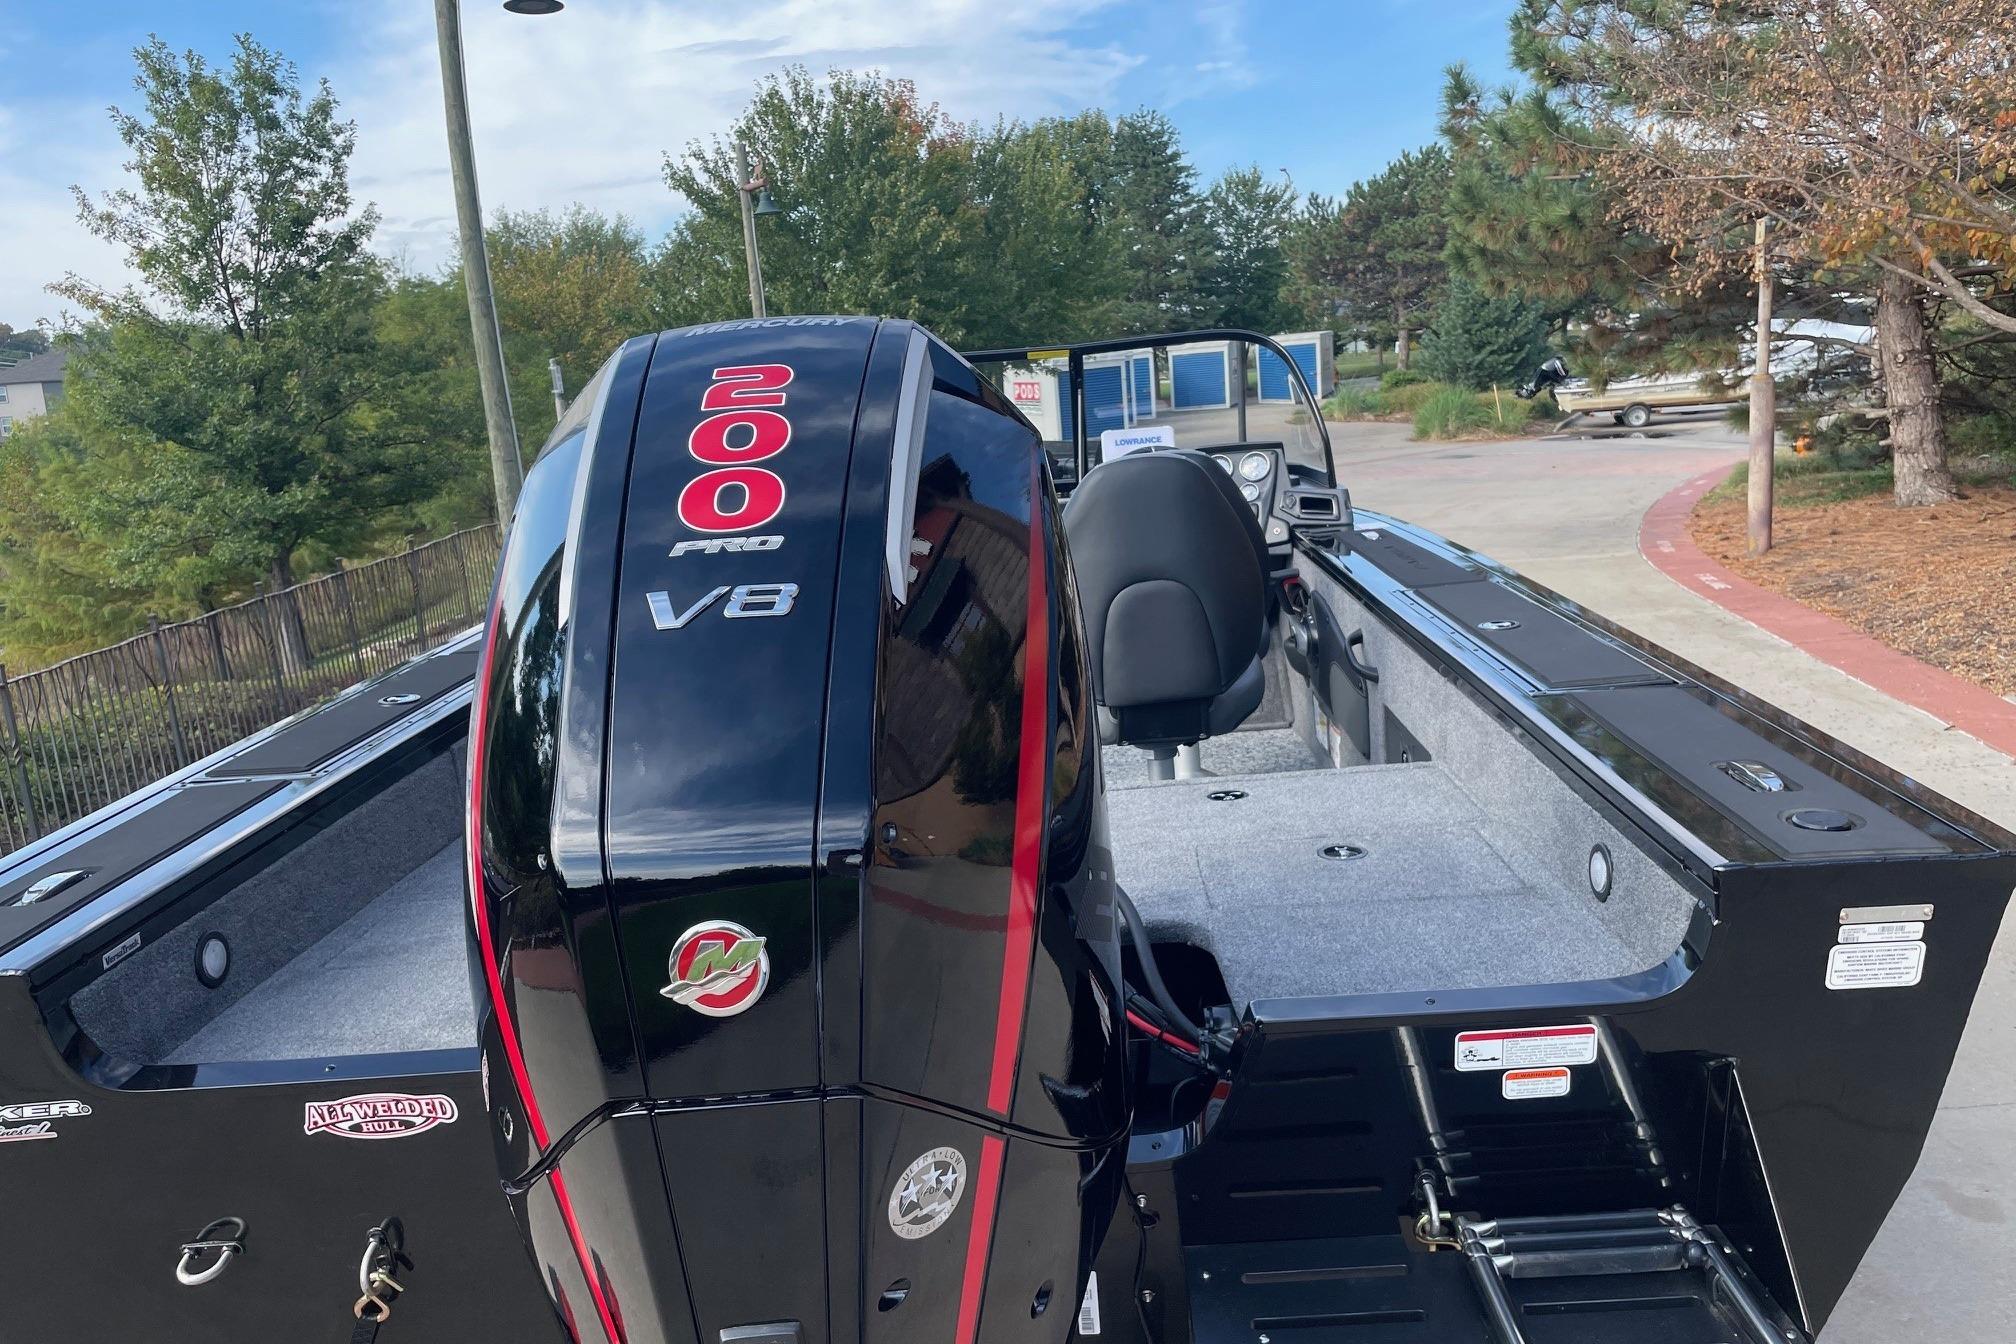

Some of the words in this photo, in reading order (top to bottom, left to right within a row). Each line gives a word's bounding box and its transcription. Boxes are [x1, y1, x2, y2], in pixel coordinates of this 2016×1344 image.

[684, 318, 860, 337] MERCURY
[1013, 383, 1040, 399] PODS
[677, 363, 794, 532] 200
[1114, 436, 1162, 447] LOWRANCE
[668, 534, 785, 557] PRO
[645, 582, 800, 631] V8
[308, 1104, 352, 1129] ALL
[351, 1098, 454, 1119] WELDED
[360, 1120, 405, 1132] HULL
